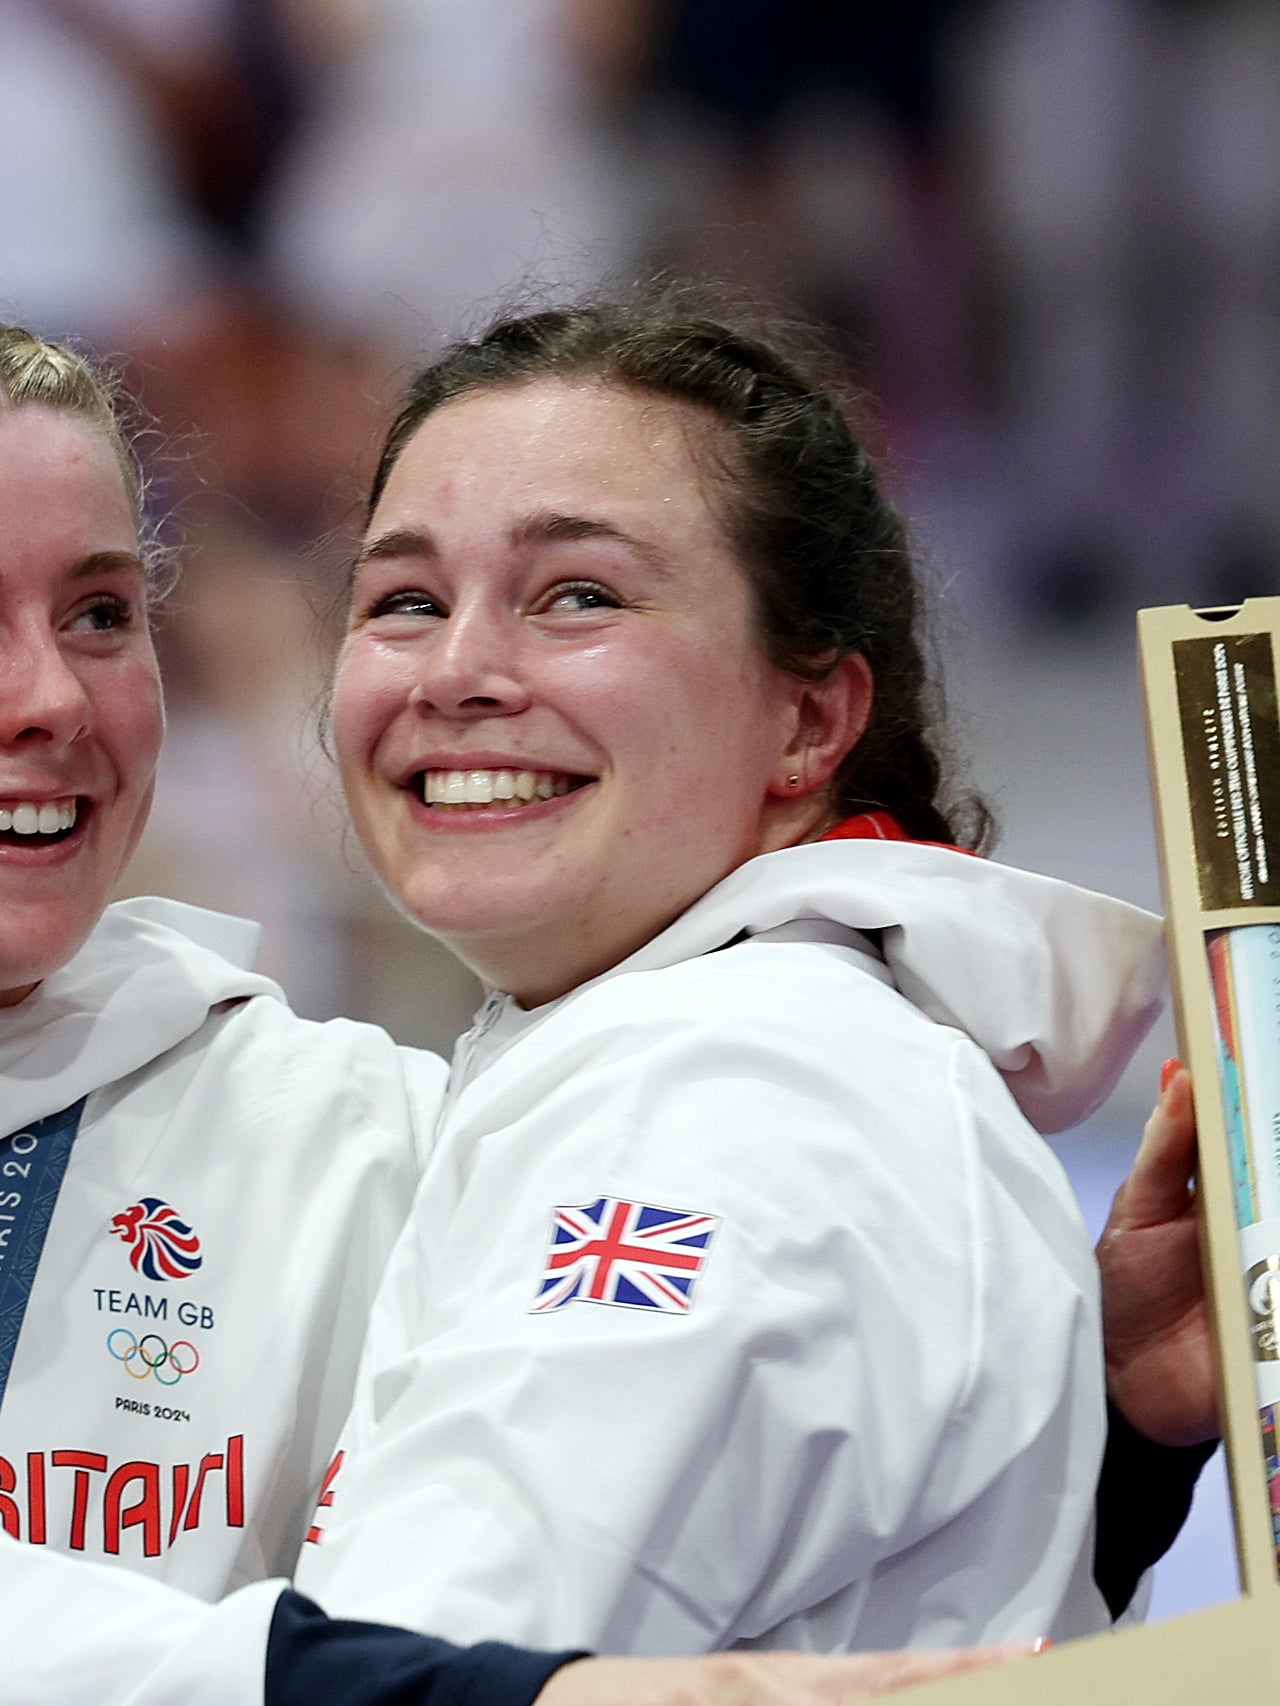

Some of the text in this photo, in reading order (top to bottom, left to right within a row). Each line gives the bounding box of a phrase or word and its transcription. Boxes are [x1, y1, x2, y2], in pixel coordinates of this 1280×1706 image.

[93, 1289, 214, 1330] TEAM GB
[153, 1405, 190, 1422] 2024
